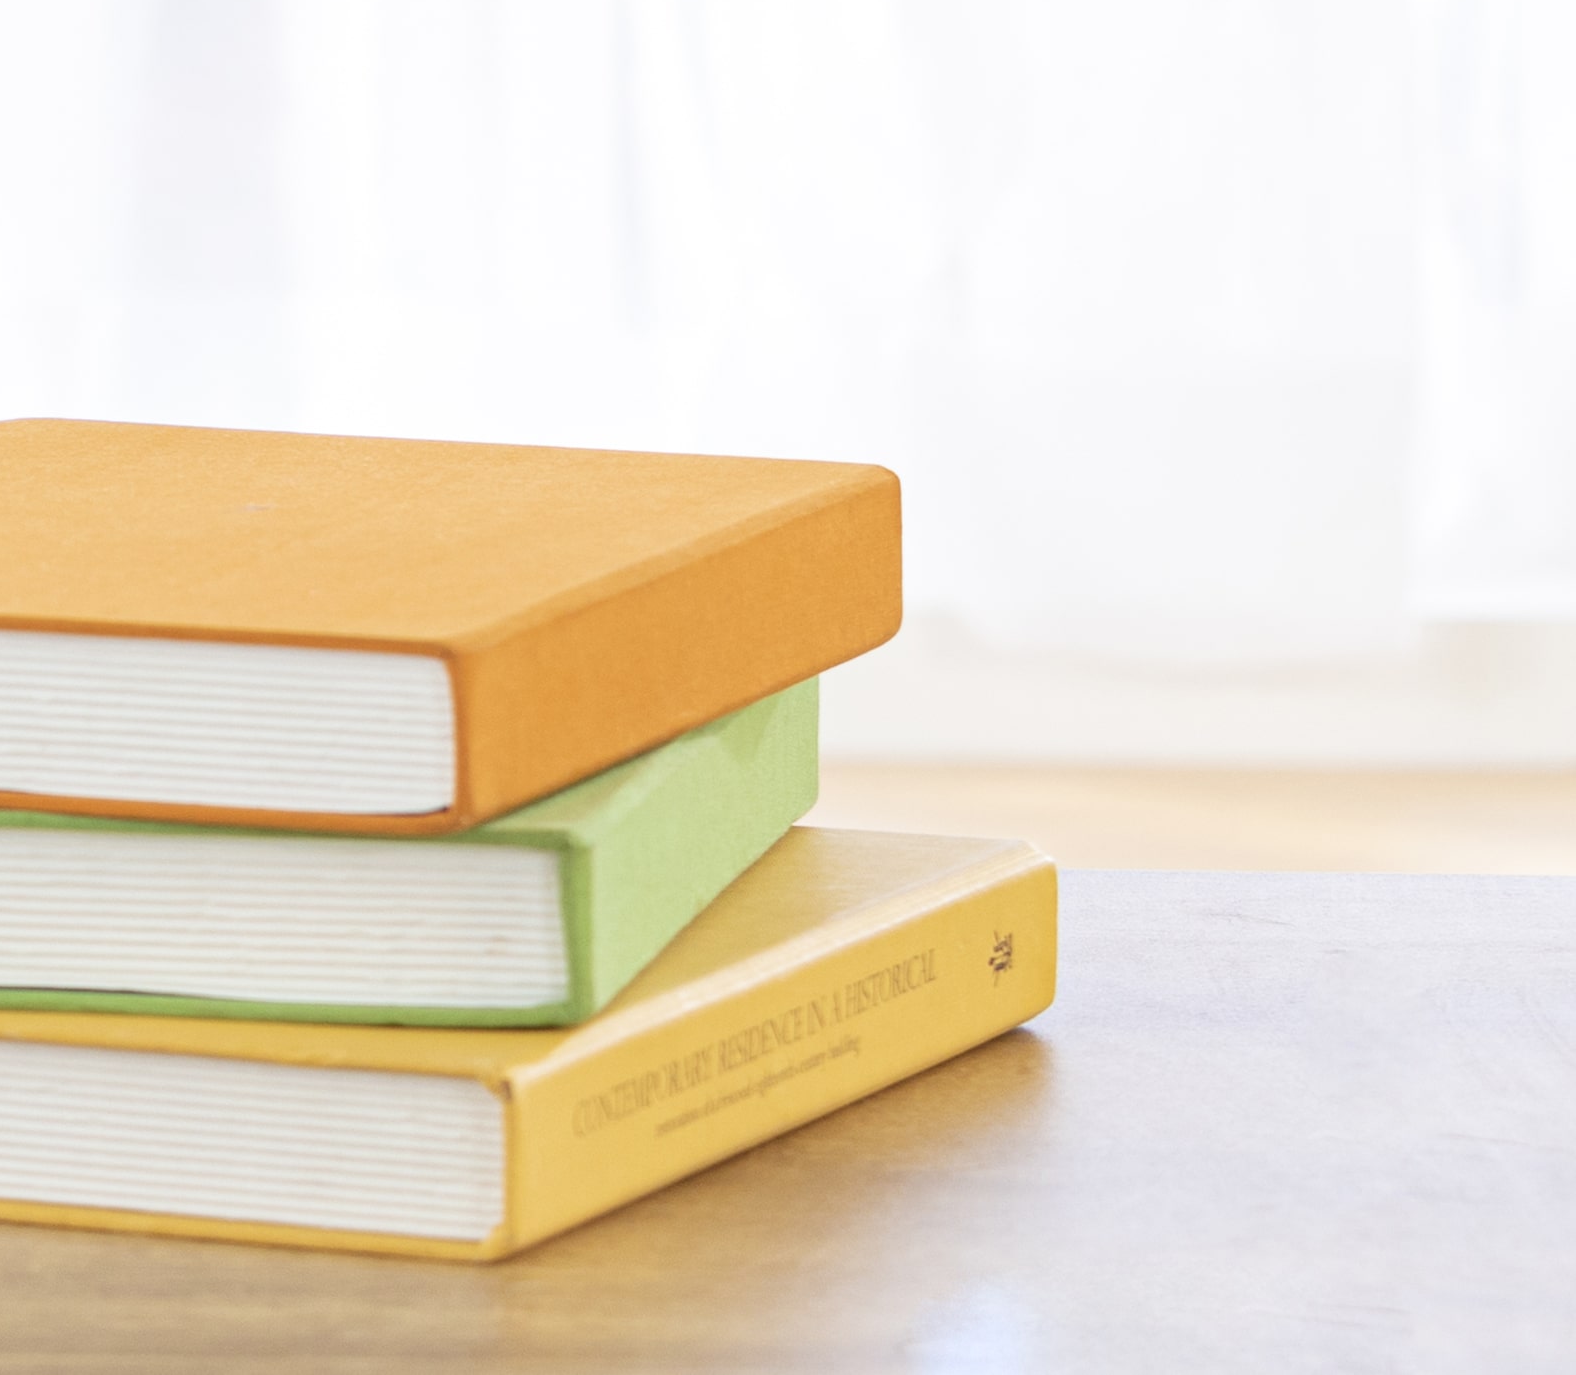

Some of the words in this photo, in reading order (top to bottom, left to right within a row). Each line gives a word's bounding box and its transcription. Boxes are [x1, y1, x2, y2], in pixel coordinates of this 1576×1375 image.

[572, 1045, 711, 1137] CONTEMPORARY
[718, 1008, 805, 1074] RESIDENCE
[806, 998, 829, 1037] IN
[829, 991, 844, 1025] A
[845, 948, 937, 1020] HISTORICAL
